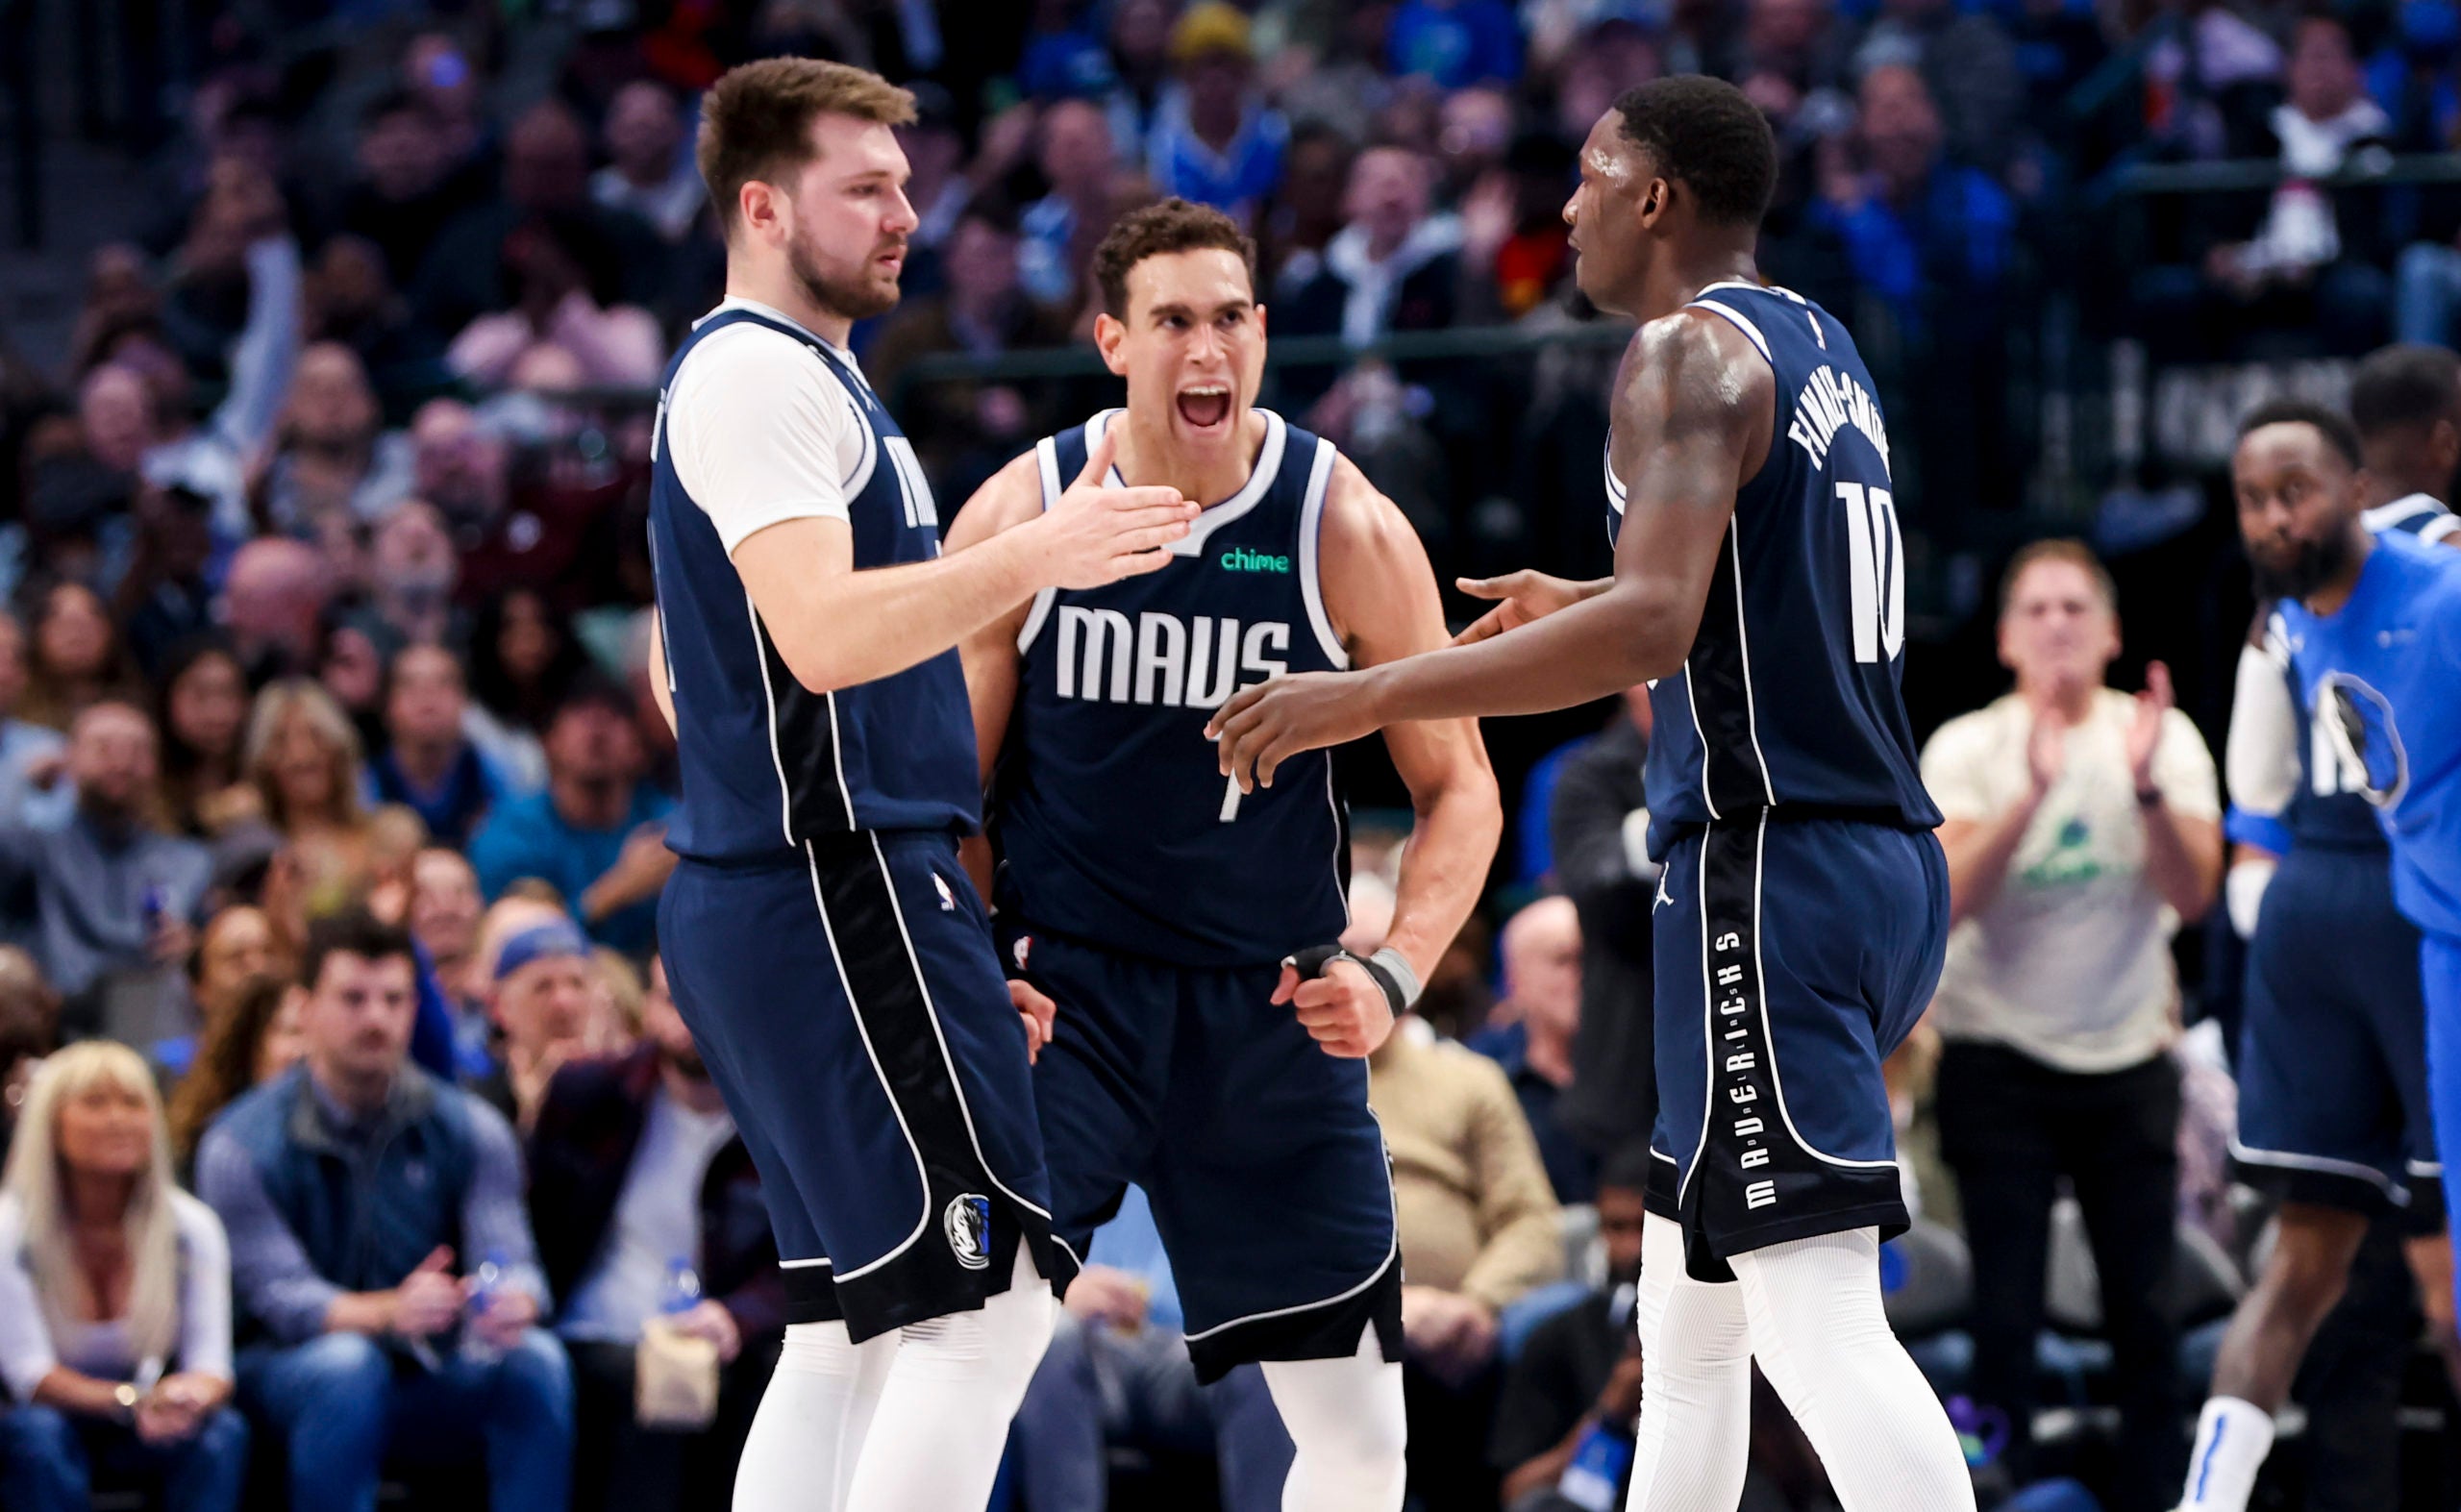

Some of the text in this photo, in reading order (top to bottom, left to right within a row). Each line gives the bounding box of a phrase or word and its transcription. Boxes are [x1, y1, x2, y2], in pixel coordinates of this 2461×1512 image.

[1221, 547, 1289, 573] chime
[1835, 482, 1905, 662] 10
[1057, 606, 1289, 709] MAVS
[1715, 931, 1777, 1210] MAVERICKS
